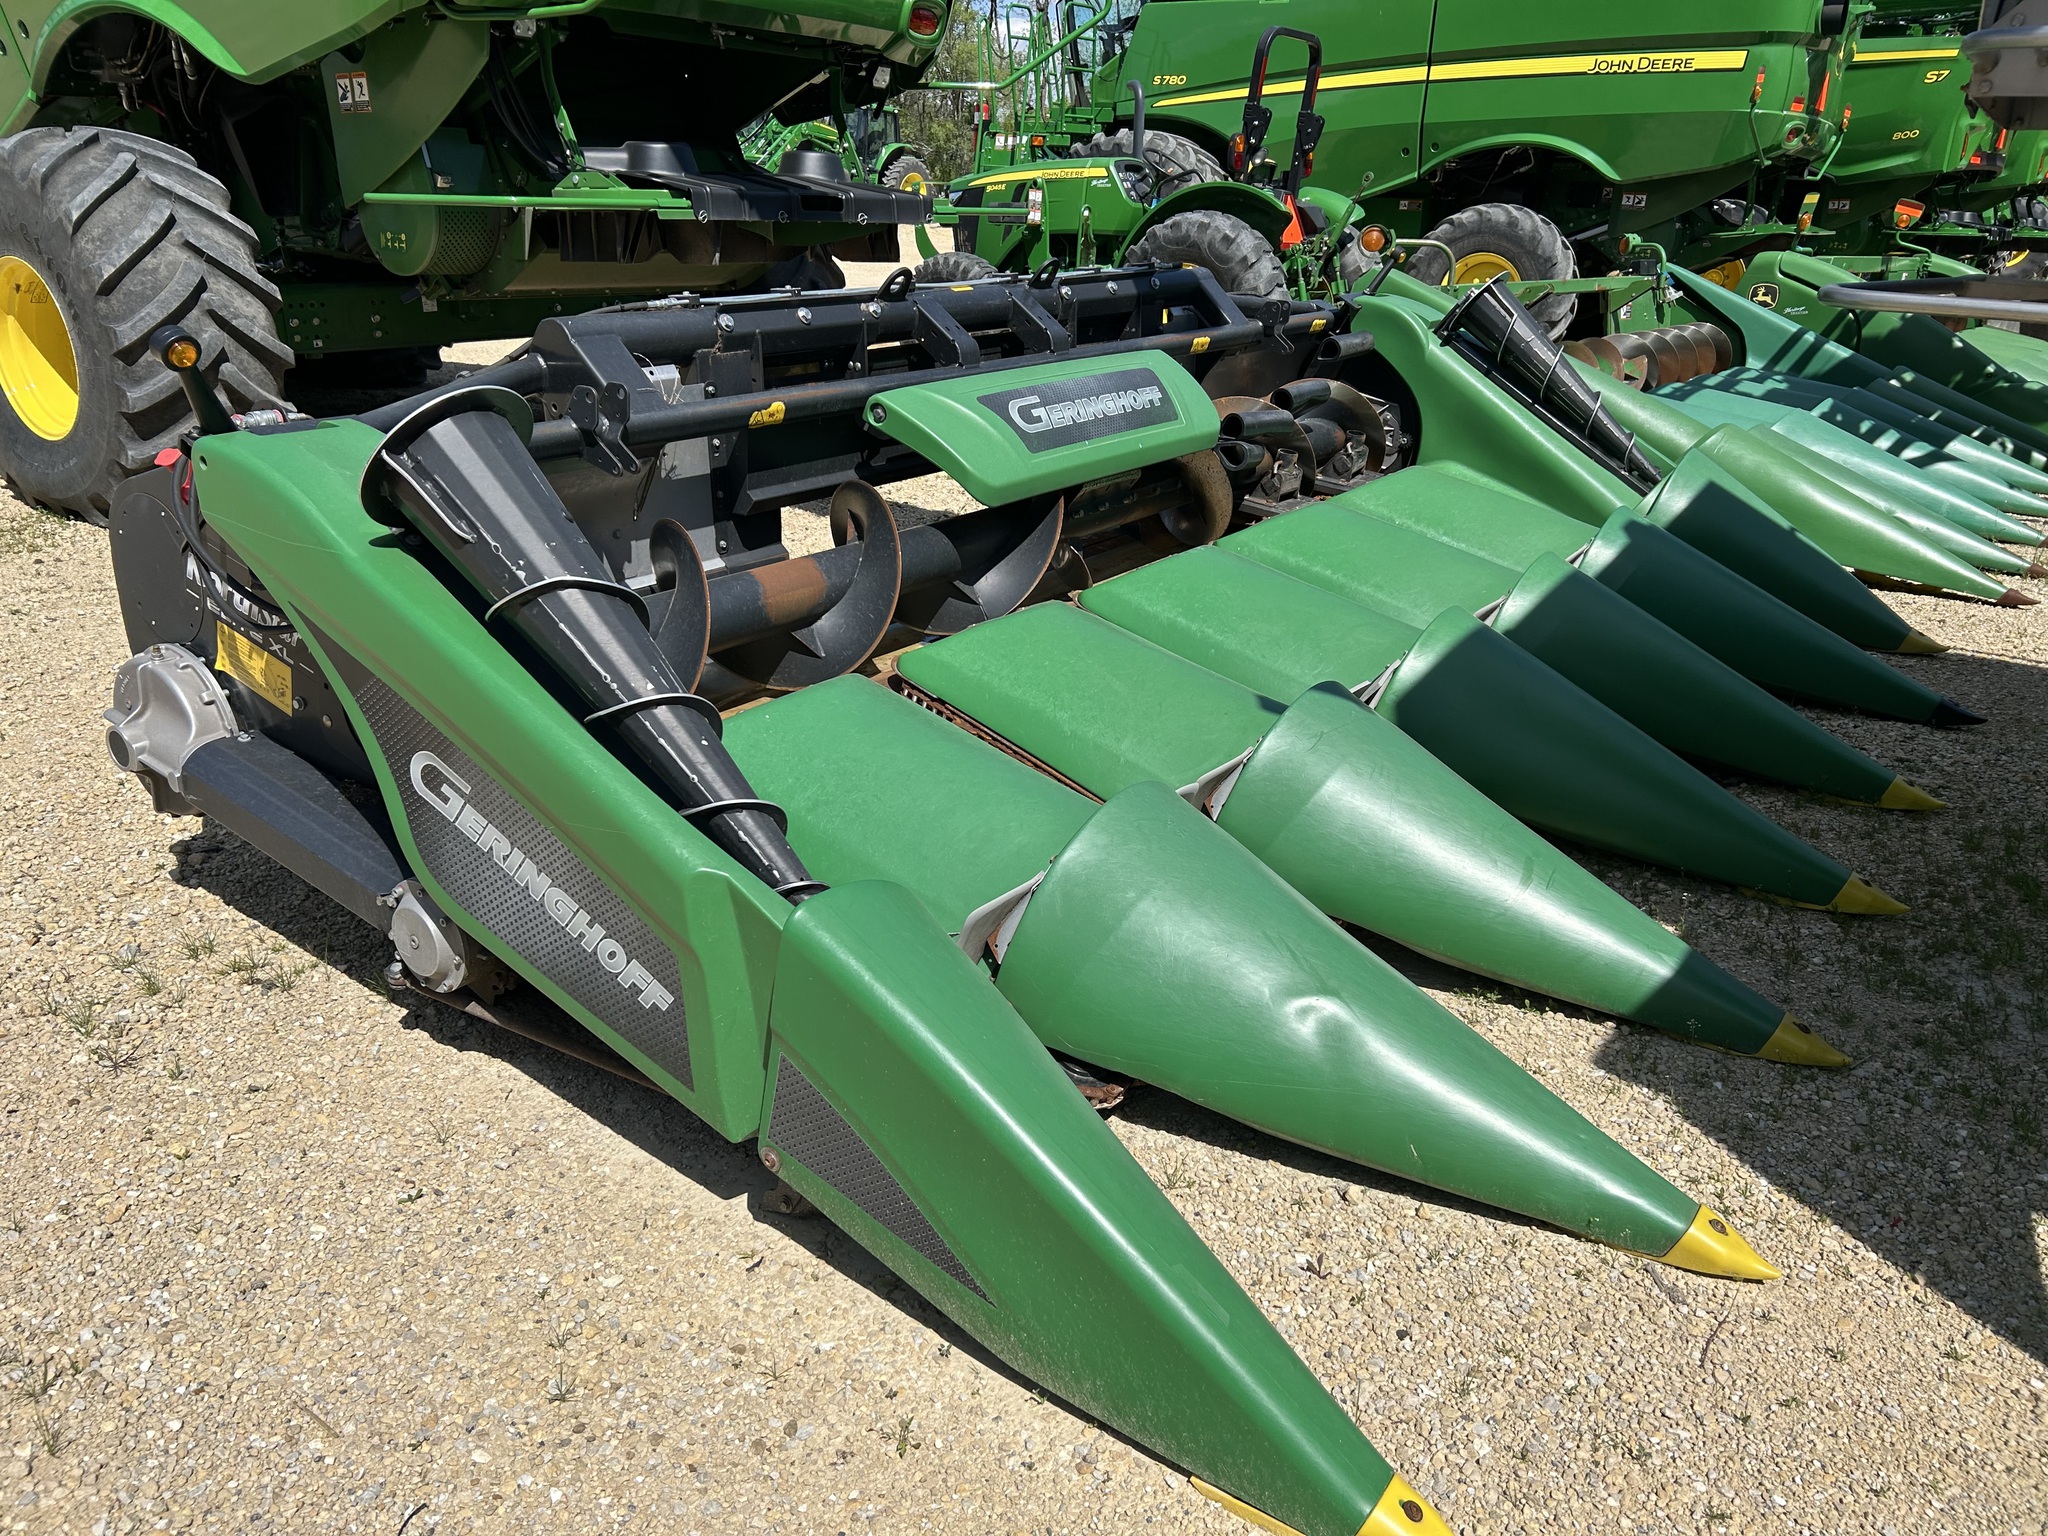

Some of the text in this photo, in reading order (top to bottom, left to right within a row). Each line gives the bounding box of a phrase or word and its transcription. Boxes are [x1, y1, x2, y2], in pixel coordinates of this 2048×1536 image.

[1587, 56, 1695, 72] JOHN DEERE
[1152, 75, 1187, 85] S780
[1924, 69, 1951, 83] S7
[1892, 129, 1920, 140] 800
[1041, 170, 1085, 179] JOHN DEERE
[1008, 385, 1163, 434] GERINGHOFF
[269, 637, 295, 665] XL
[409, 750, 675, 1011] GERINGHOFF
